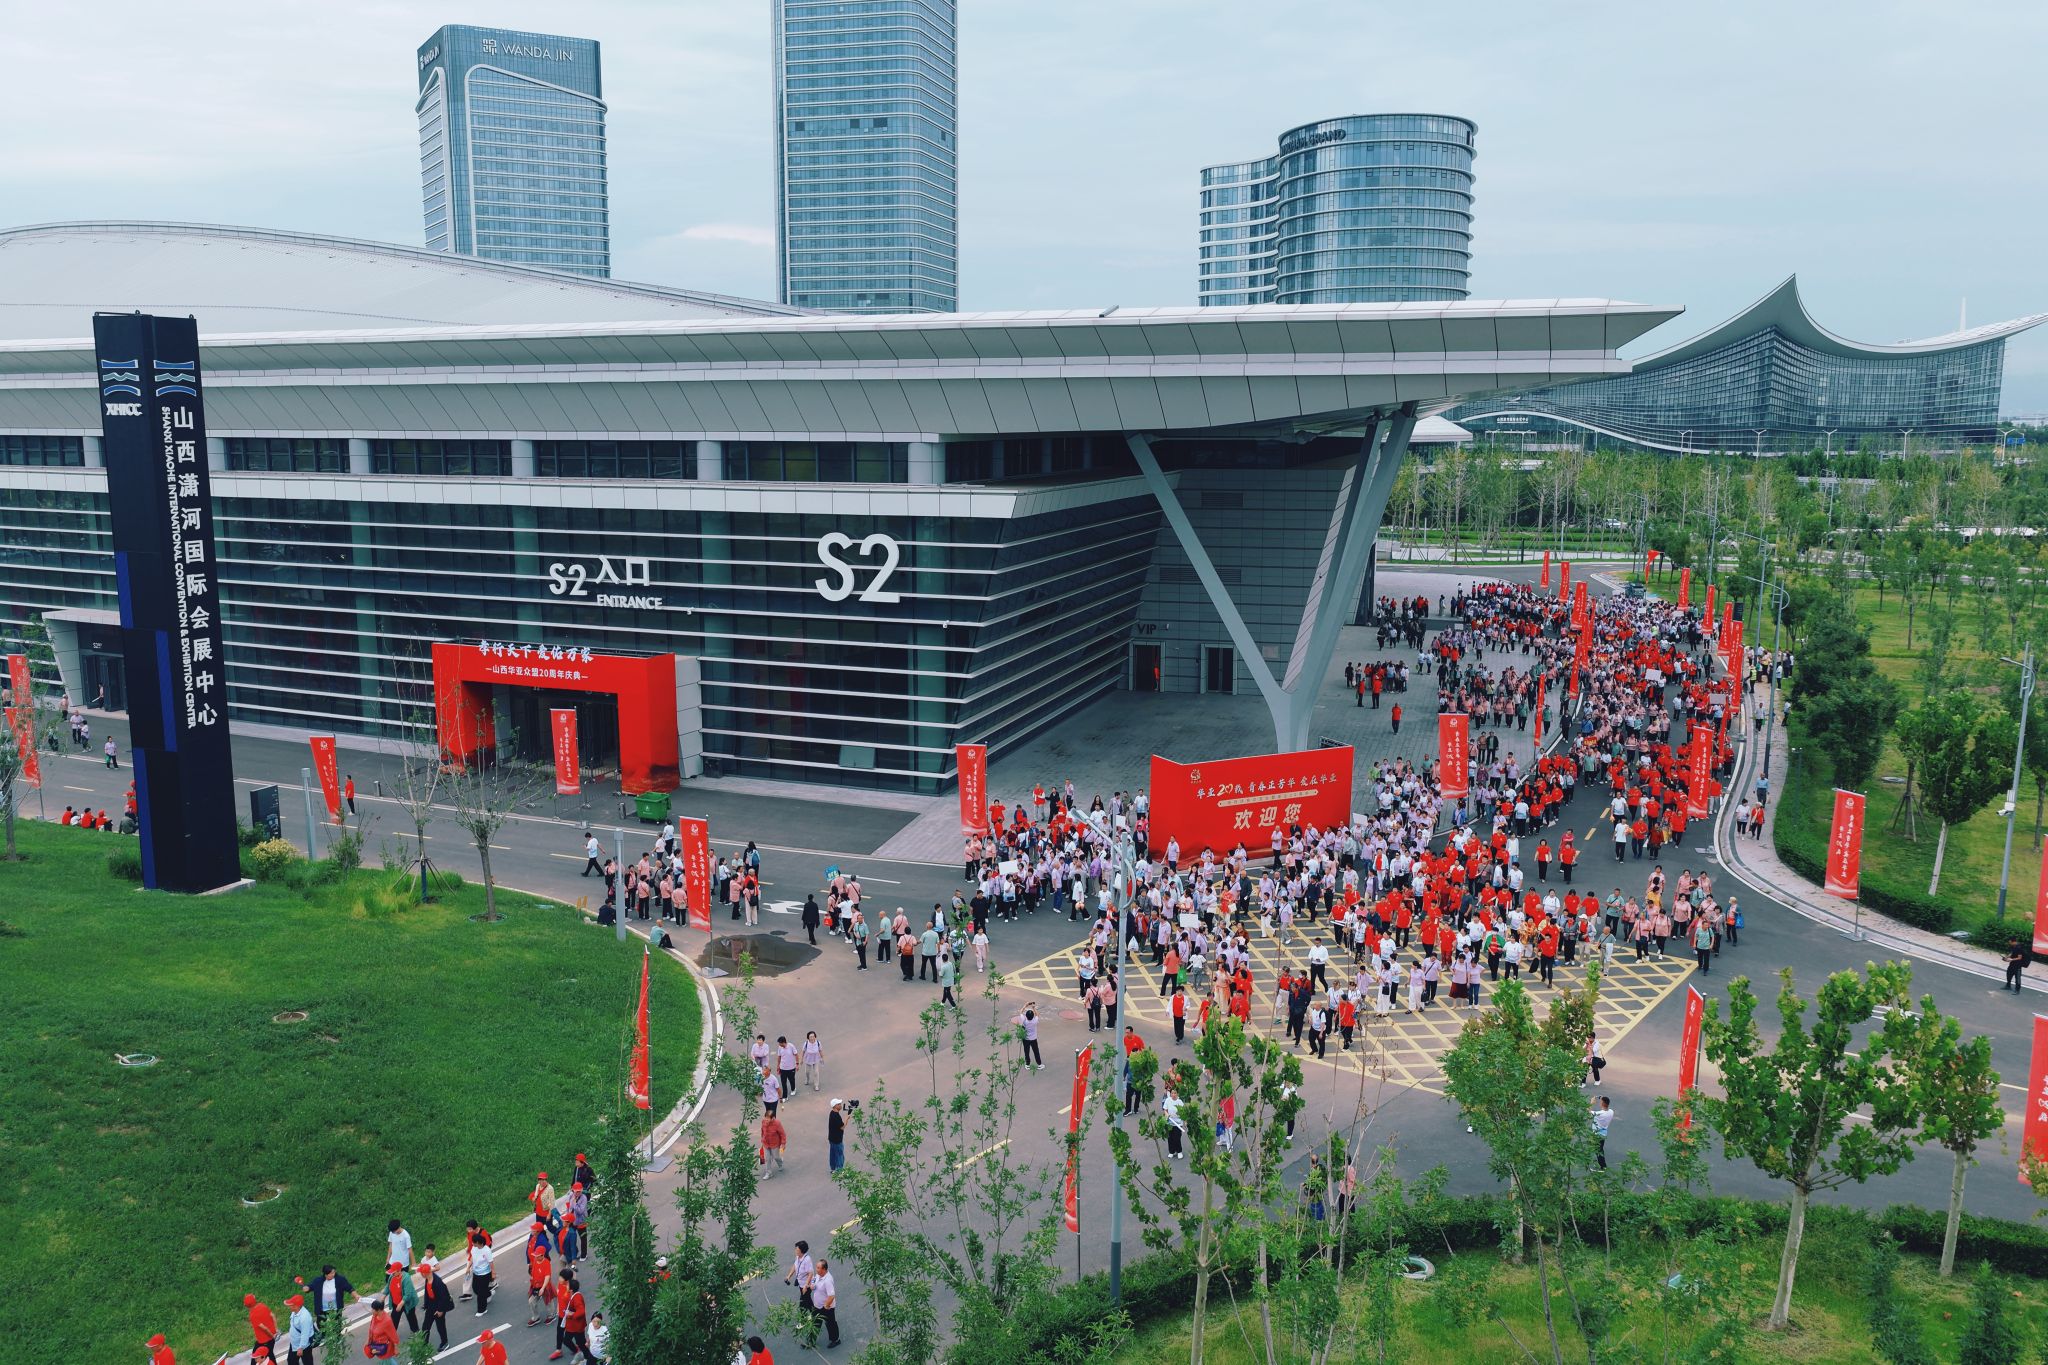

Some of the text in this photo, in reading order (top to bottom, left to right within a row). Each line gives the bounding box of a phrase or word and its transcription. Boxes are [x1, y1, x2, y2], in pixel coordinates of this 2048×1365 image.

[503, 43, 573, 62] WANDA JIN
[162, 406, 197, 729] SHANXI XIAOHE INTERNATIONAL CONVENTION & EXHIBITION CENTER
[173, 406, 218, 726] 山西潇河国际会展中心
[815, 532, 901, 603] S2
[596, 594, 662, 610] ENTRANCE
[1137, 623, 1157, 635] VIP
[1233, 803, 1302, 831] 欢迎您
